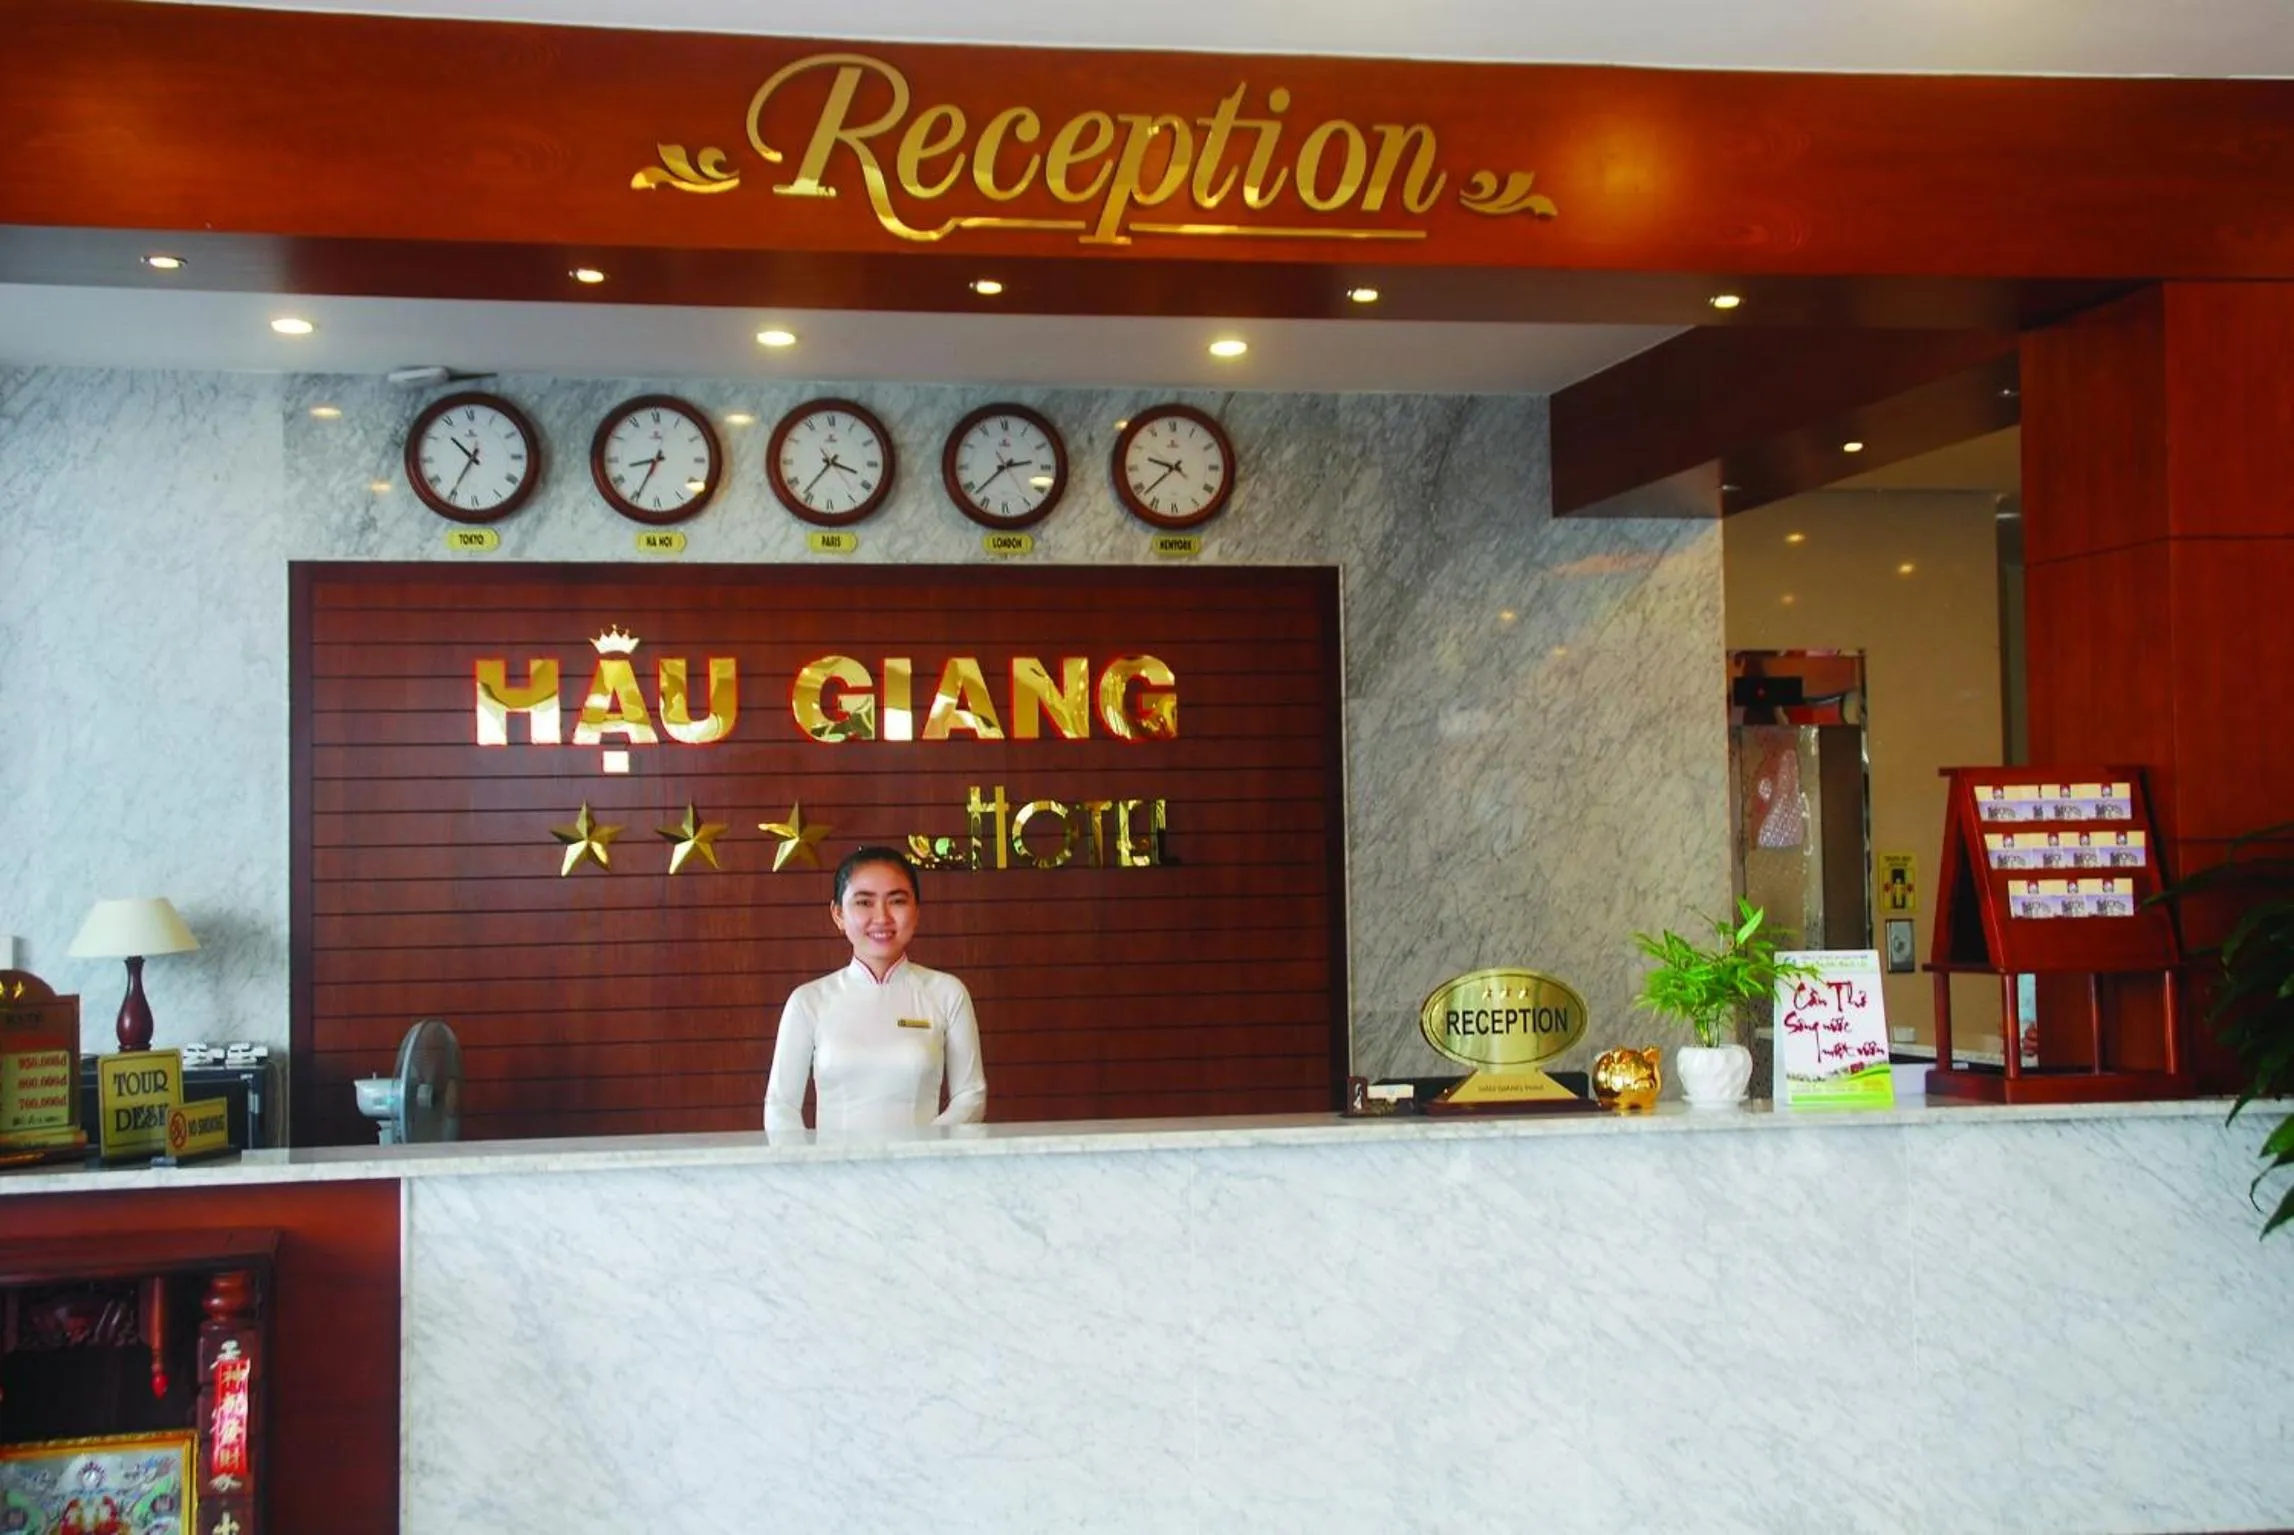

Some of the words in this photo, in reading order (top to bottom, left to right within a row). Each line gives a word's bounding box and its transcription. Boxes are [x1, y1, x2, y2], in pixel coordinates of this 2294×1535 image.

[745, 52, 1447, 245] Reception
[458, 533, 485, 546] TOKYO
[820, 536, 842, 548] PARIS
[992, 537, 1023, 549] LONDON
[788, 654, 1180, 743] GIANG
[1446, 1007, 1569, 1036] RECEPTION
[113, 1069, 169, 1097] TOUR
